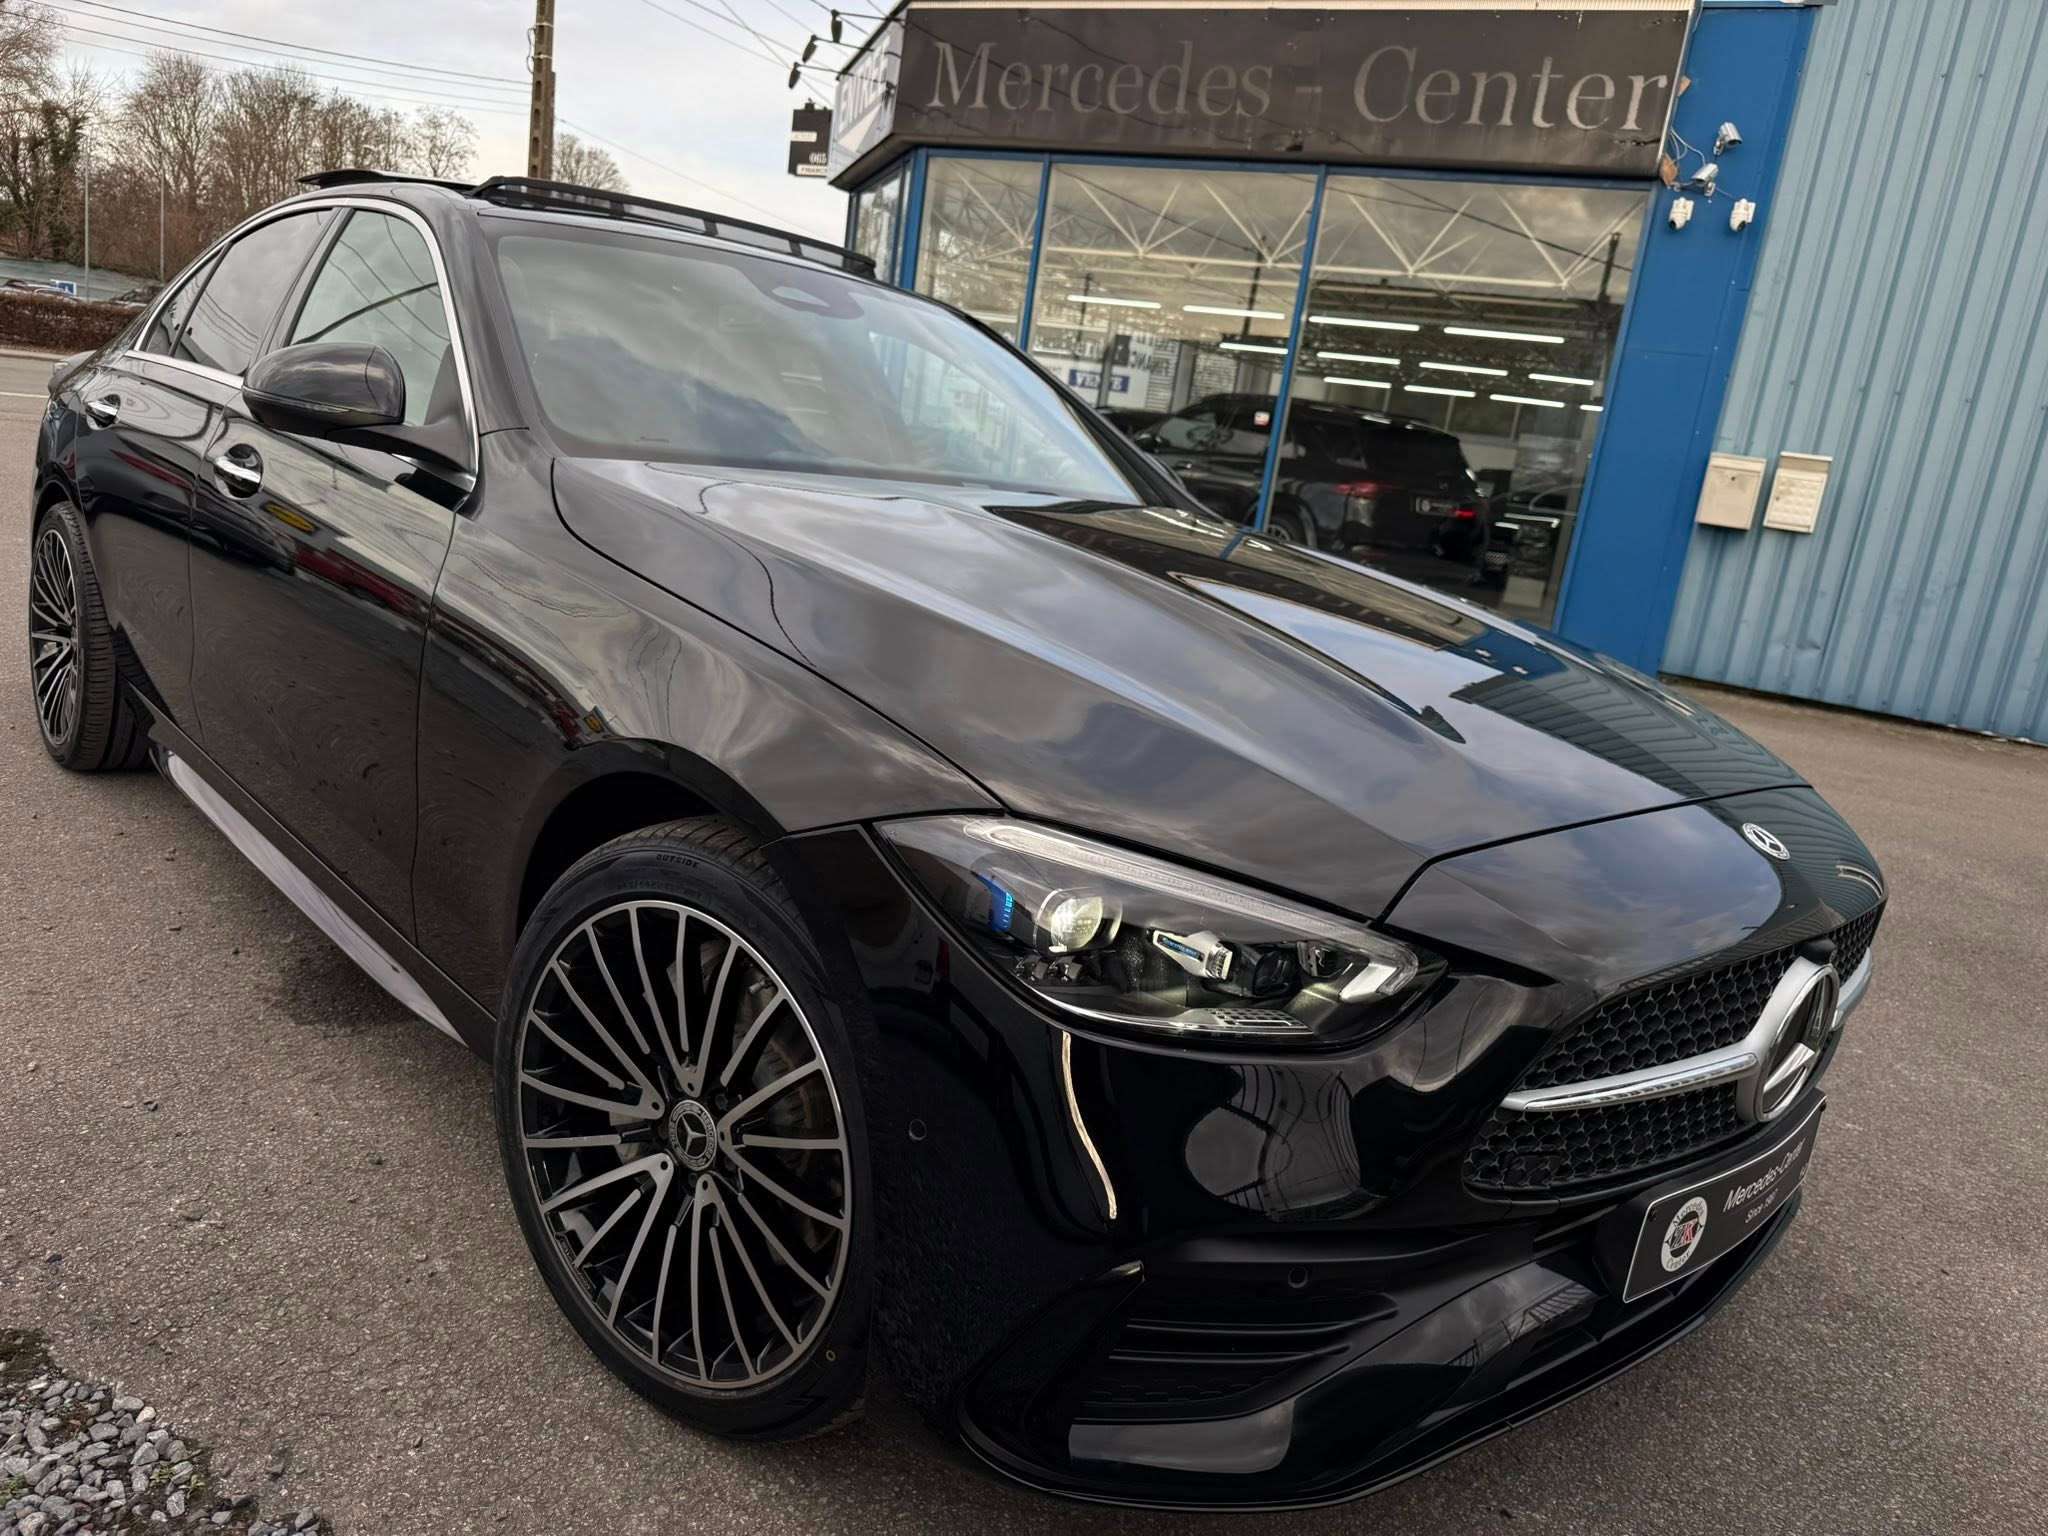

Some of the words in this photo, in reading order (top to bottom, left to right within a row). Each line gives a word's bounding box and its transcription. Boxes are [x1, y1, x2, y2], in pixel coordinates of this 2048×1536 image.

[926, 40, 1273, 118] Mercedes
[1353, 45, 1668, 131] Center
[656, 854, 700, 869] OUTSIDE
